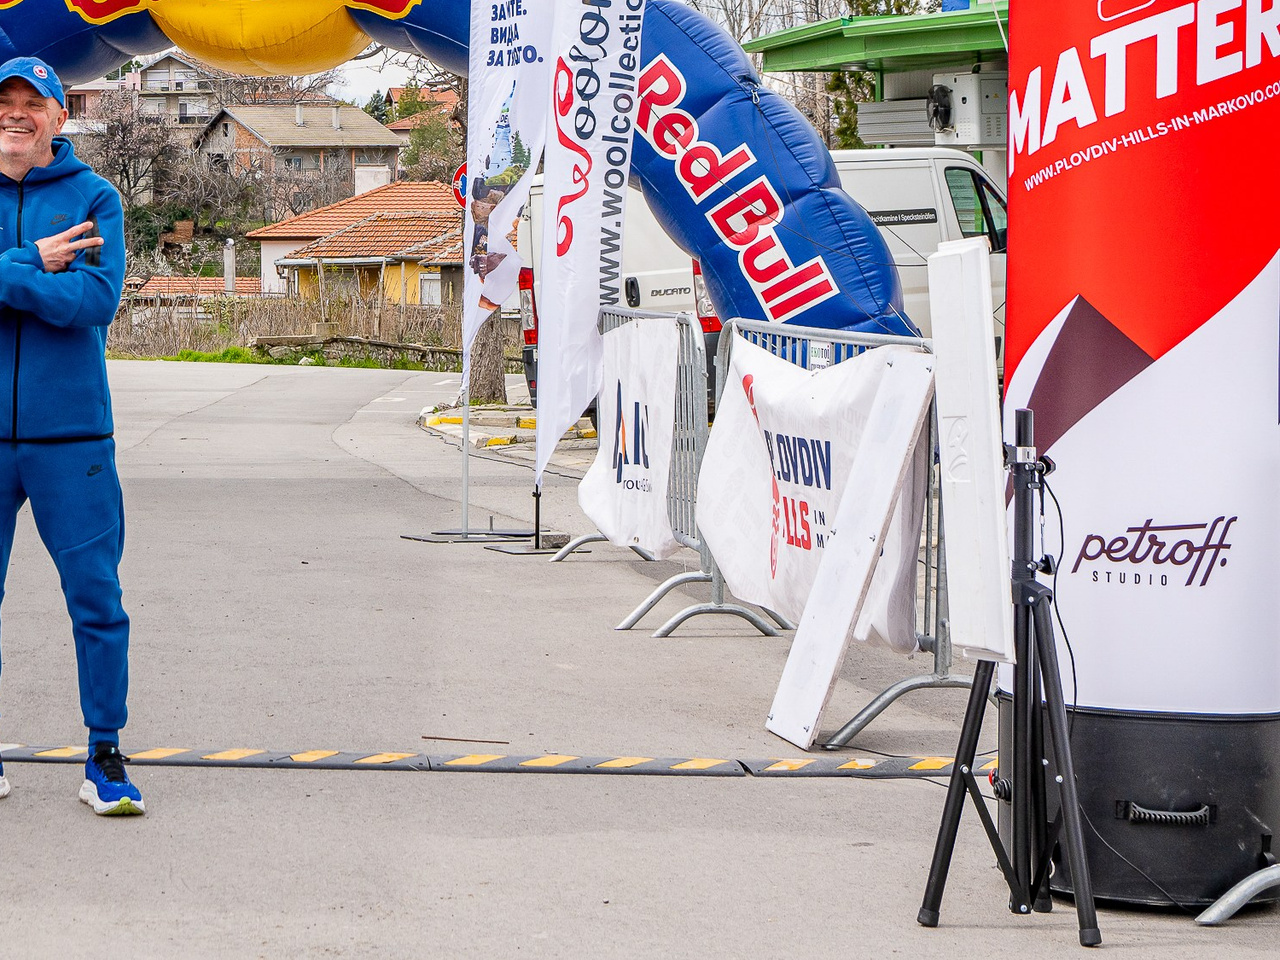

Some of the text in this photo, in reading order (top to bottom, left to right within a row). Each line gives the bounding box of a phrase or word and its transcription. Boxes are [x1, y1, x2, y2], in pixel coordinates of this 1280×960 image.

[635, 56, 836, 322] Red Bull
[650, 287, 691, 297] DUCATO
[764, 429, 831, 491] POVDIV
[814, 509, 826, 526] IN
[1092, 570, 1168, 587] STUDIO
